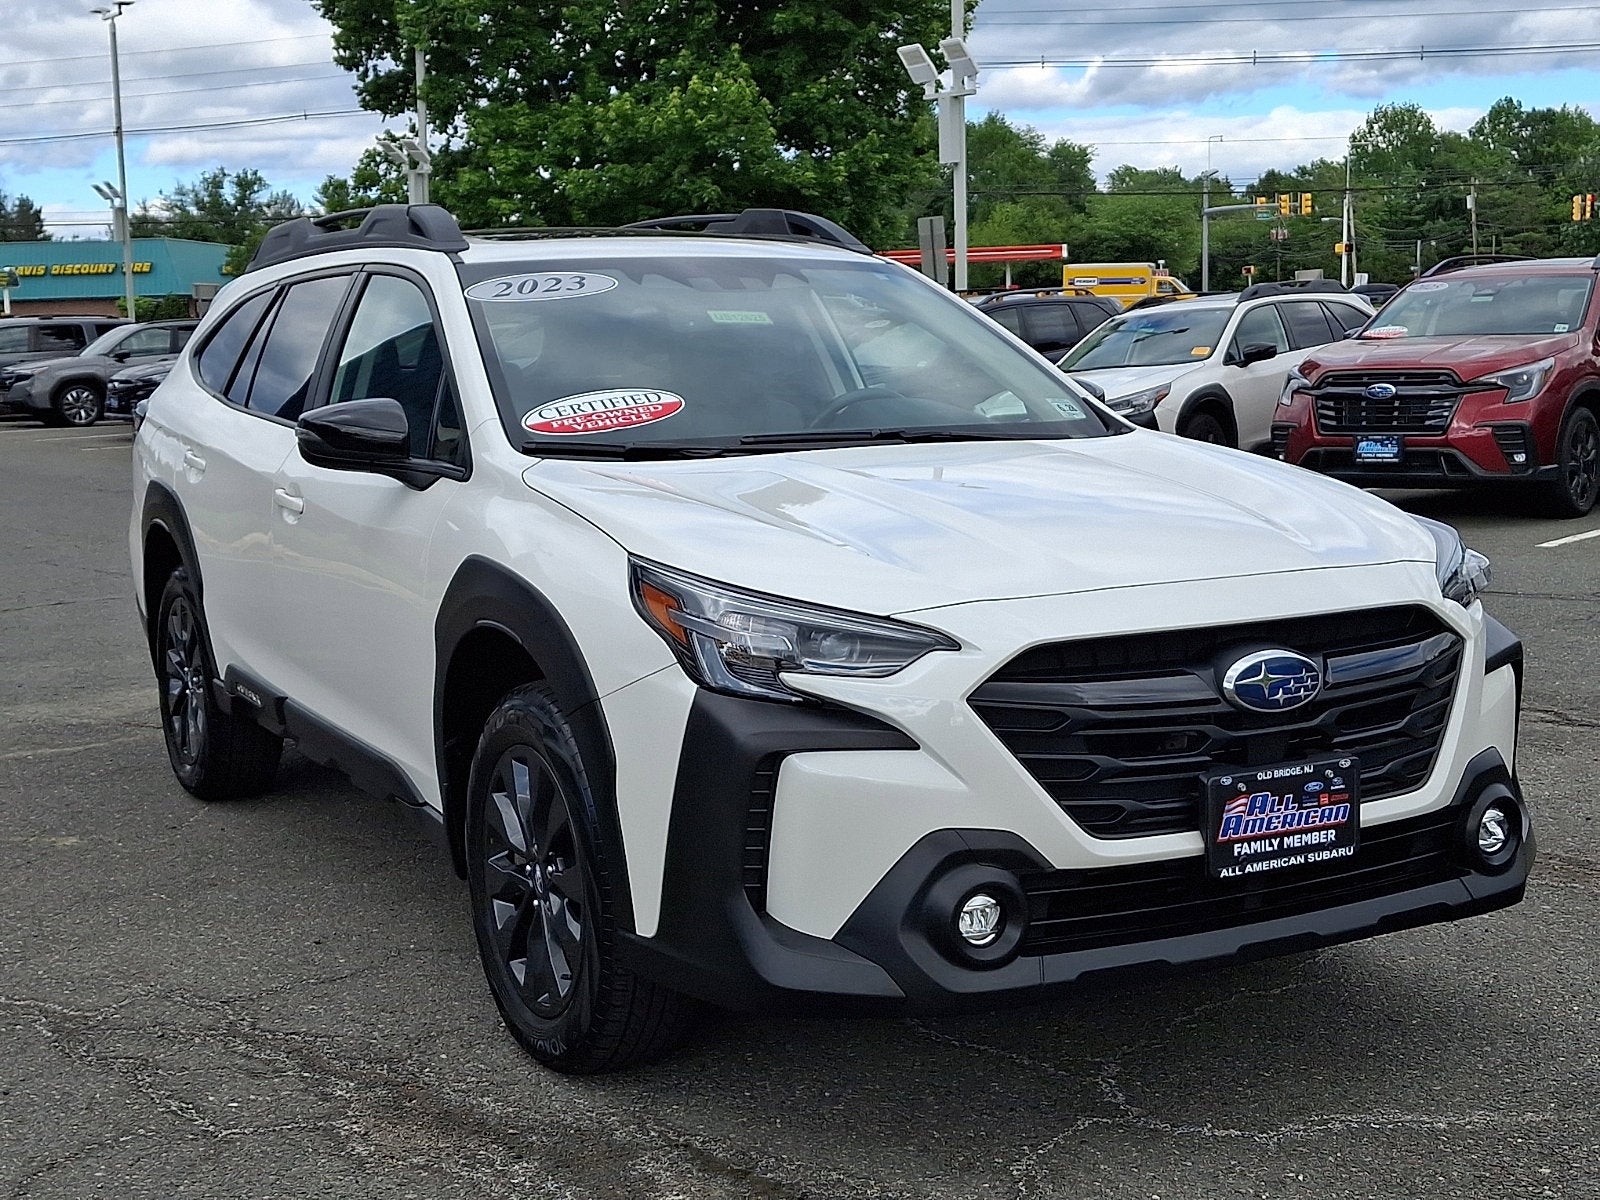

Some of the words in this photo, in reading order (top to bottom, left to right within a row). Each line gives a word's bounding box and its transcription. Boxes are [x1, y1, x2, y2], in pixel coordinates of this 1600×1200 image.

[51, 263, 116, 275] DISCOUNT
[492, 275, 586, 298] 2023
[538, 392, 662, 420] CERTIFIED
[551, 404, 663, 428] PRE-OWNED
[571, 413, 652, 431] VEHICLE
[1257, 772, 1272, 780] OLD
[1304, 765, 1314, 774] NJ
[1246, 792, 1298, 816] ALL
[1219, 804, 1350, 840] AMERICAN
[1234, 838, 1280, 856] FAMILY
[1284, 829, 1336, 848] MEMBER
[1220, 866, 1242, 878] ALL
[1245, 855, 1305, 873] AMERICAN
[1308, 846, 1354, 862] SUBARU
